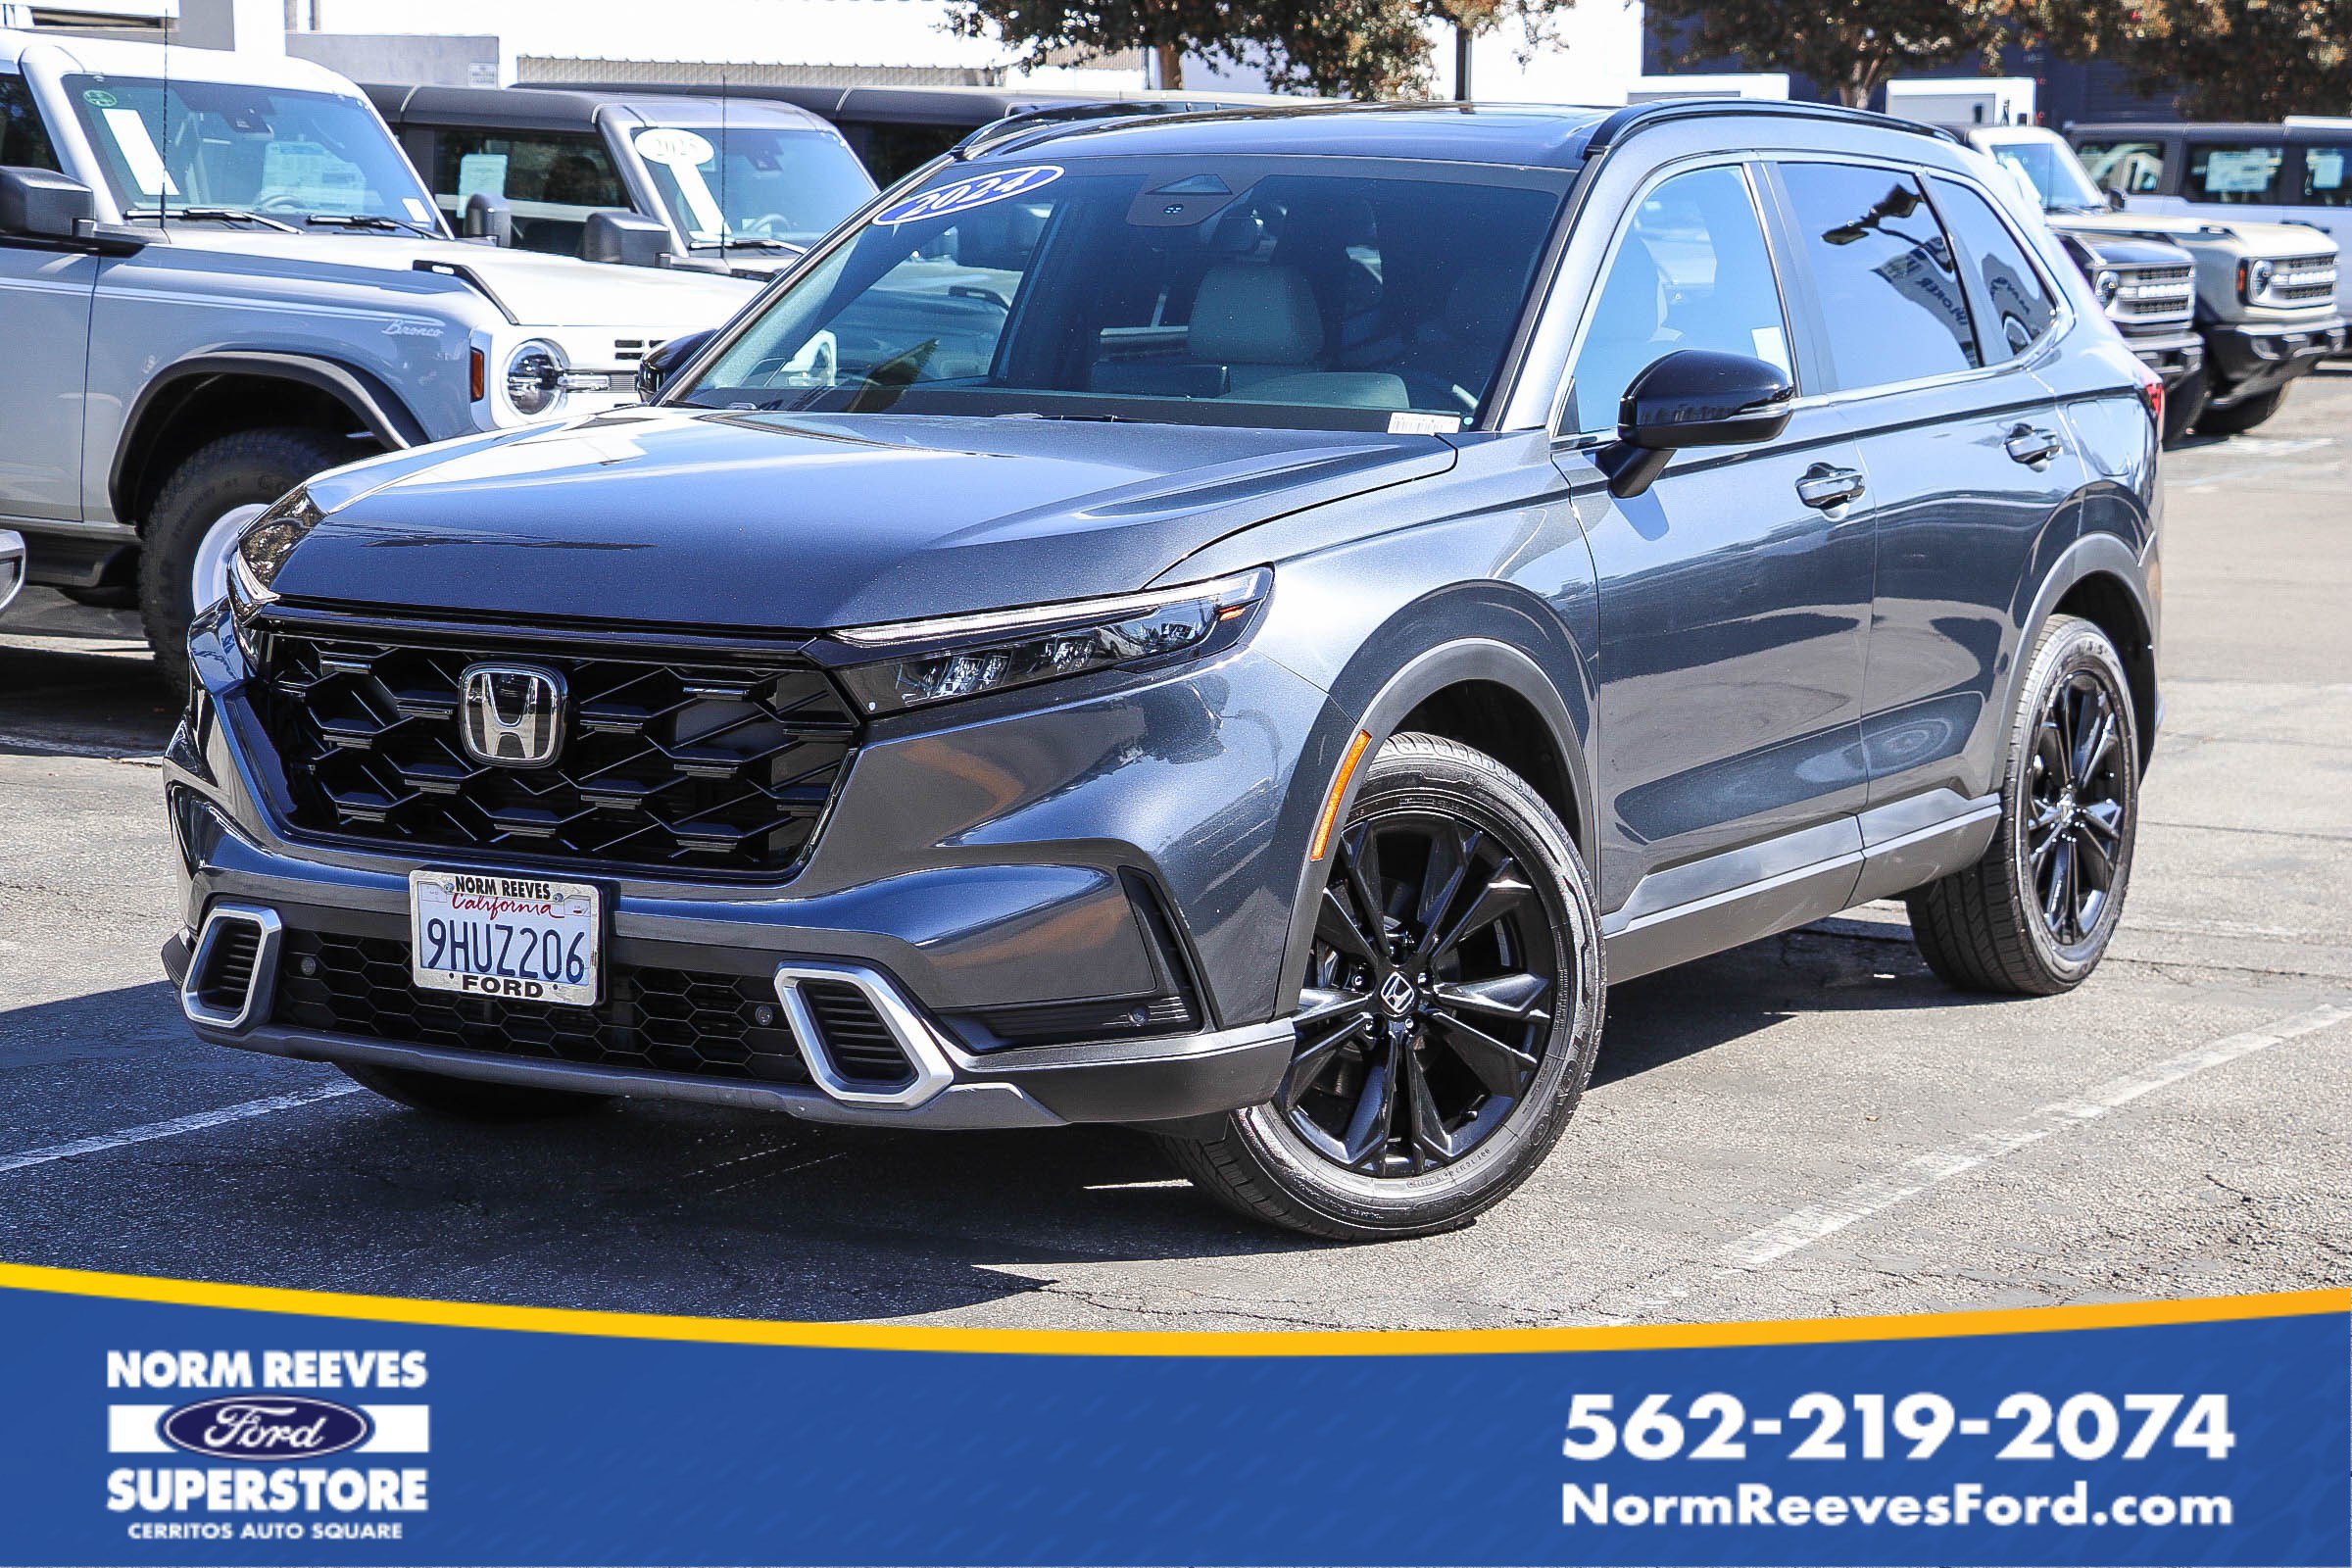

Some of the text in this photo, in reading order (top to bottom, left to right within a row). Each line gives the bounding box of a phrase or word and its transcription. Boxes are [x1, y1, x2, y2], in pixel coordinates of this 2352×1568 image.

[896, 170, 1039, 220] 2024
[381, 319, 444, 337] Bronco
[455, 875, 551, 900] NORM REEVES
[452, 892, 565, 920] California
[427, 917, 586, 984] 9HUZ206
[463, 975, 544, 998] FORD
[1530, 1031, 1591, 1146] TOYO
